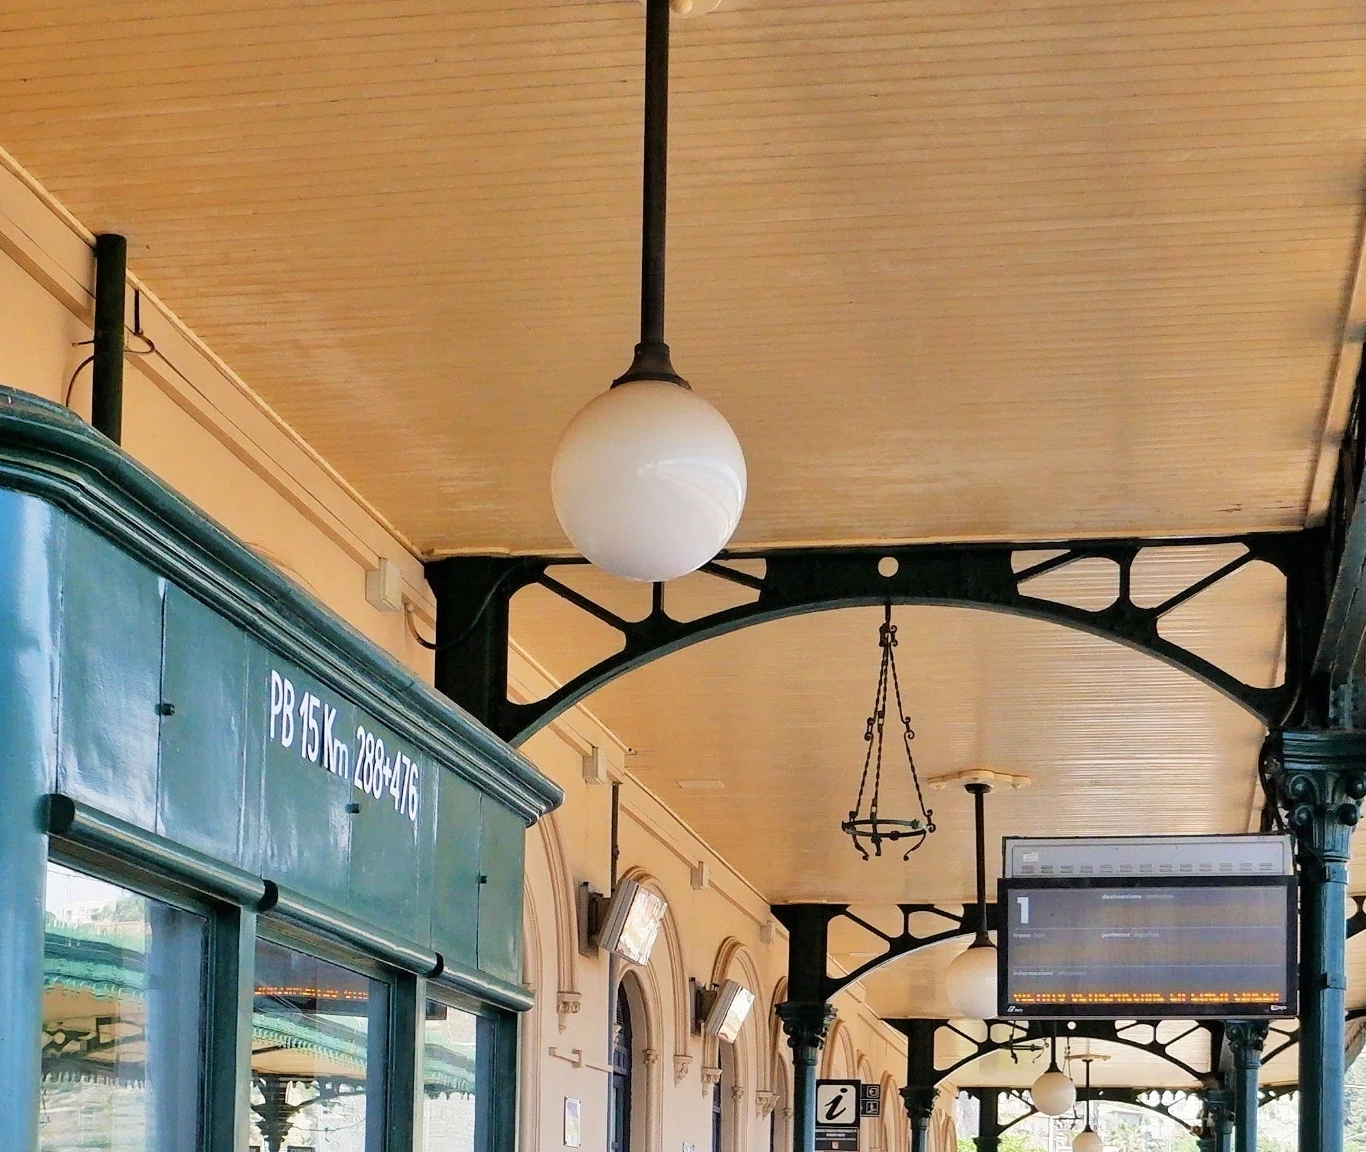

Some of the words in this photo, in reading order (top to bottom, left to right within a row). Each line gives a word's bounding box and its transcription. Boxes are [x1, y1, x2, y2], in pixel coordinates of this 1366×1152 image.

[269, 668, 296, 748] PB
[299, 691, 321, 763] 15
[323, 703, 349, 780] Km
[354, 725, 419, 821] 288+476
[1016, 896, 1029, 924] 1
[824, 1087, 849, 1121] i
